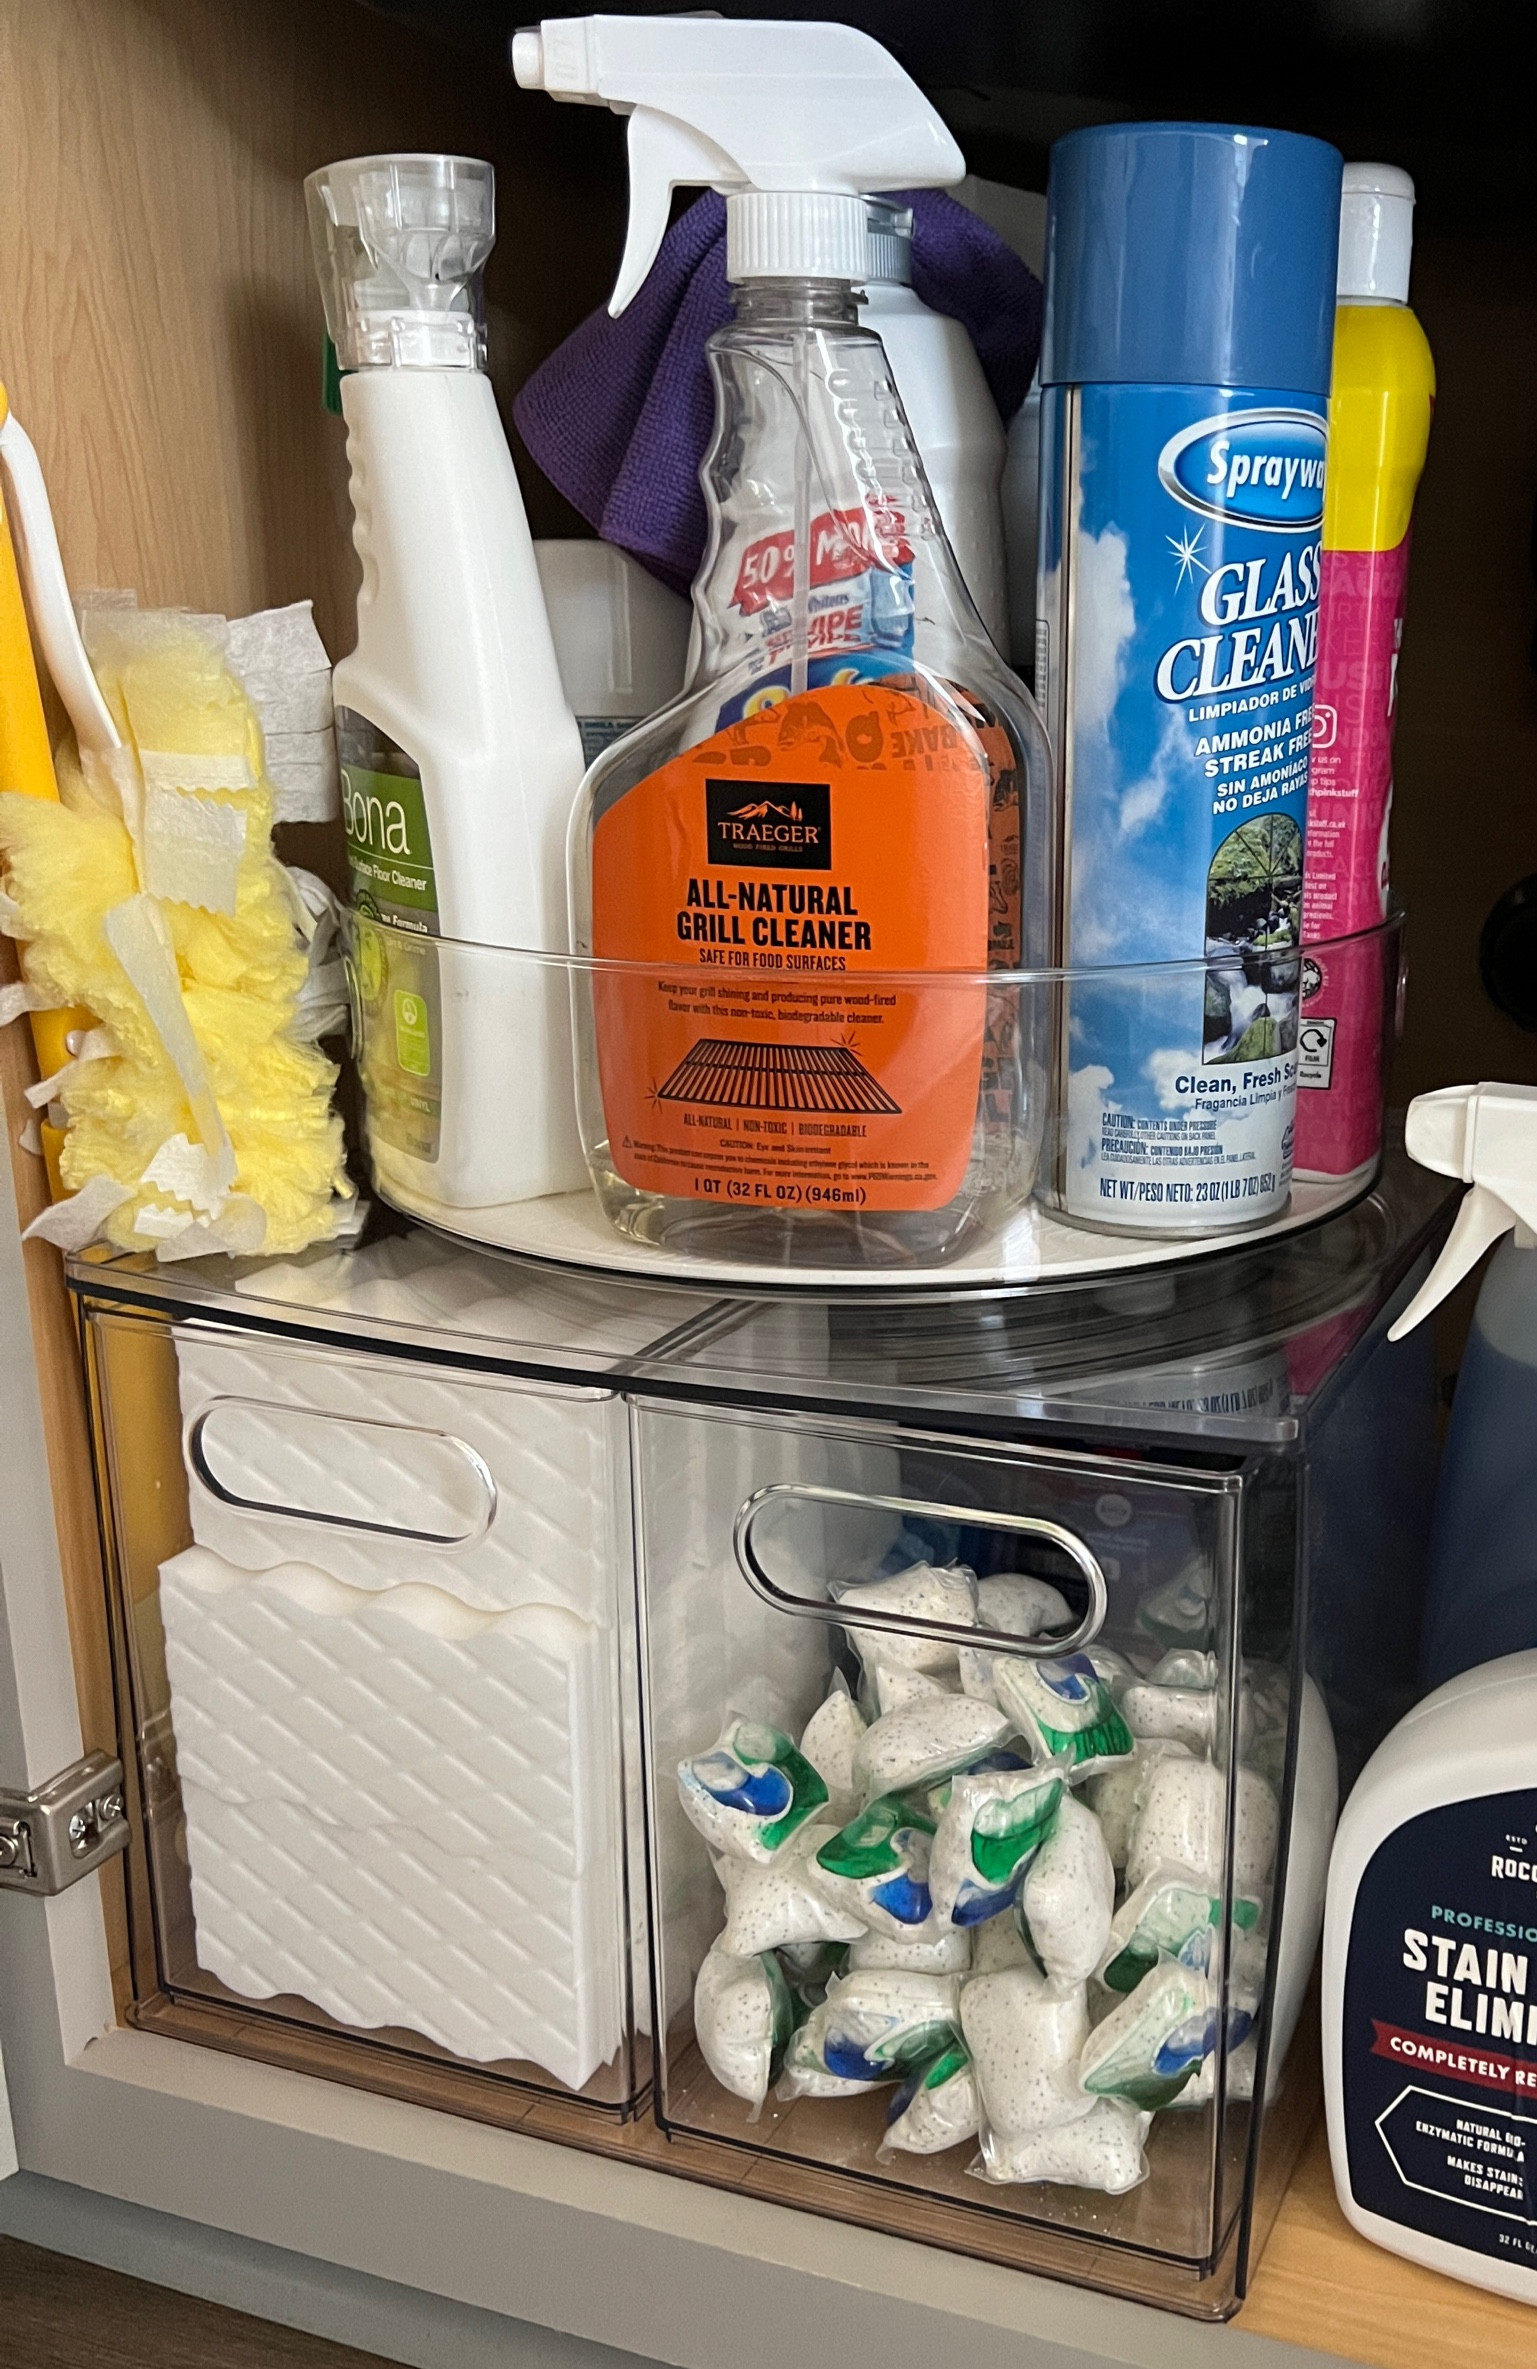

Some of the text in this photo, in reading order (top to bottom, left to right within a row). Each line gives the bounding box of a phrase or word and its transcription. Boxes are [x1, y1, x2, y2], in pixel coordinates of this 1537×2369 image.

[1200, 540, 1322, 626] GLASS
[1189, 691, 1280, 722] LIMPIADOR
[1283, 684, 1297, 701] DE
[1194, 717, 1291, 757] AMMONIA
[1205, 742, 1284, 778] STREAK
[1288, 728, 1313, 756] FREE
[1217, 779, 1246, 797] SIN
[1251, 756, 1308, 790] AMONÍACO
[1212, 798, 1237, 815] NO
[1243, 787, 1278, 809] DEJA
[1281, 771, 1308, 796] RAYAS
[718, 821, 819, 843] TRAEGER
[373, 864, 391, 882] Floor
[392, 870, 427, 890] Cleaner
[687, 878, 858, 916] ALL-NATURAL
[677, 911, 871, 950] GRILL CLEANER
[700, 949, 846, 971] SAFE FOR FOOD SURFACES
[658, 981, 896, 1006] Keep your grill shining and producing pure wood-fired
[668, 999, 885, 1024] flavor with this non-toxic, biodegradable cleaner.
[1175, 1076, 1236, 1094] Clean,
[1243, 1066, 1281, 1089] Fresh
[1195, 1095, 1247, 1112] Fragancia
[1250, 1090, 1276, 1105] Limpia
[684, 1113, 867, 1137] ALL-NATURAL NON-TOXIC BIODEGRADABLE
[704, 1179, 721, 1193] QT
[727, 1180, 751, 1198] (32
[755, 1184, 772, 1198] FL
[776, 1185, 802, 1203] OZ)
[805, 1186, 866, 1205] (946ml)
[1100, 1178, 1117, 1198] NET
[1120, 1180, 1163, 1202] WT/PESO
[1166, 1183, 1194, 1202] NETO:
[1196, 1183, 1208, 1202] 23
[1210, 1182, 1220, 1201] OZ
[1230, 1179, 1240, 1198] LB
[1403, 1928, 1528, 1995] STAIN
[1390, 2036, 1537, 2088] COMPLETELY RE
[1415, 2120, 1474, 2147] ENZYMATIC
[1456, 2119, 1502, 2141] NATURAL
[1447, 2155, 1484, 2176] MAKES
[1499, 2233, 1510, 2246] 32
[1513, 2237, 1522, 2249] FL
